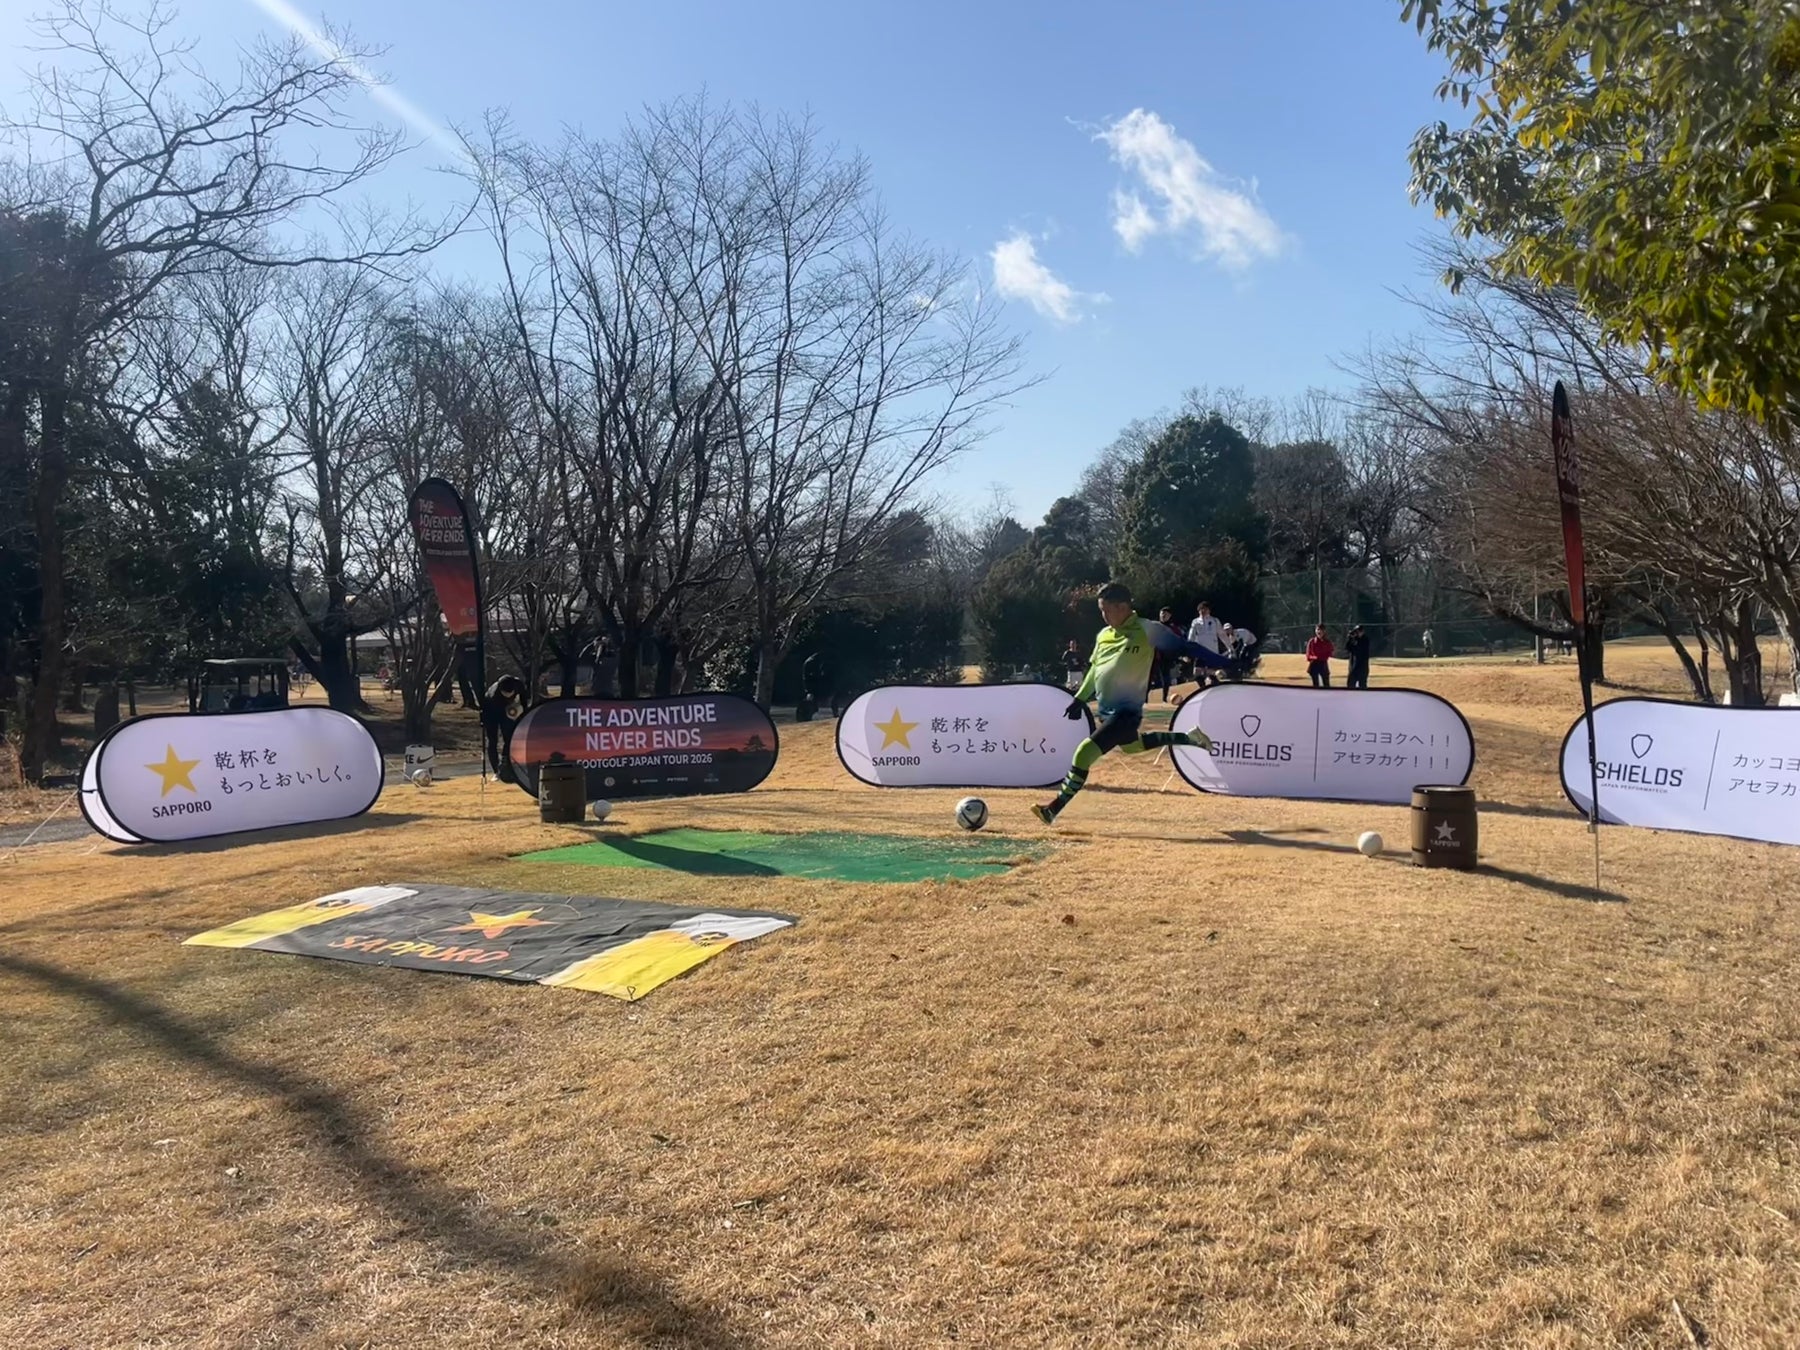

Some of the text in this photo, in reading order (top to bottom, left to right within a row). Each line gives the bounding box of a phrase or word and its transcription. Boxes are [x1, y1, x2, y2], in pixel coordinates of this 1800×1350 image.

[566, 703, 717, 727] THE ADVENTURE
[930, 717, 990, 734] 乾杯を
[586, 728, 702, 751] NEVER ENDS
[931, 738, 1057, 755] もっとおいしく。
[214, 748, 277, 771] 乾杯を
[629, 755, 661, 767] JAPAN
[662, 754, 689, 765] TOUR
[690, 753, 713, 764] 2026
[872, 755, 921, 767] SAPPORO
[1209, 740, 1292, 762] SHIELDS
[219, 765, 352, 795] もっとおいしく。
[1594, 761, 1684, 787] SHIELDS
[152, 799, 212, 818] SAPPORO
